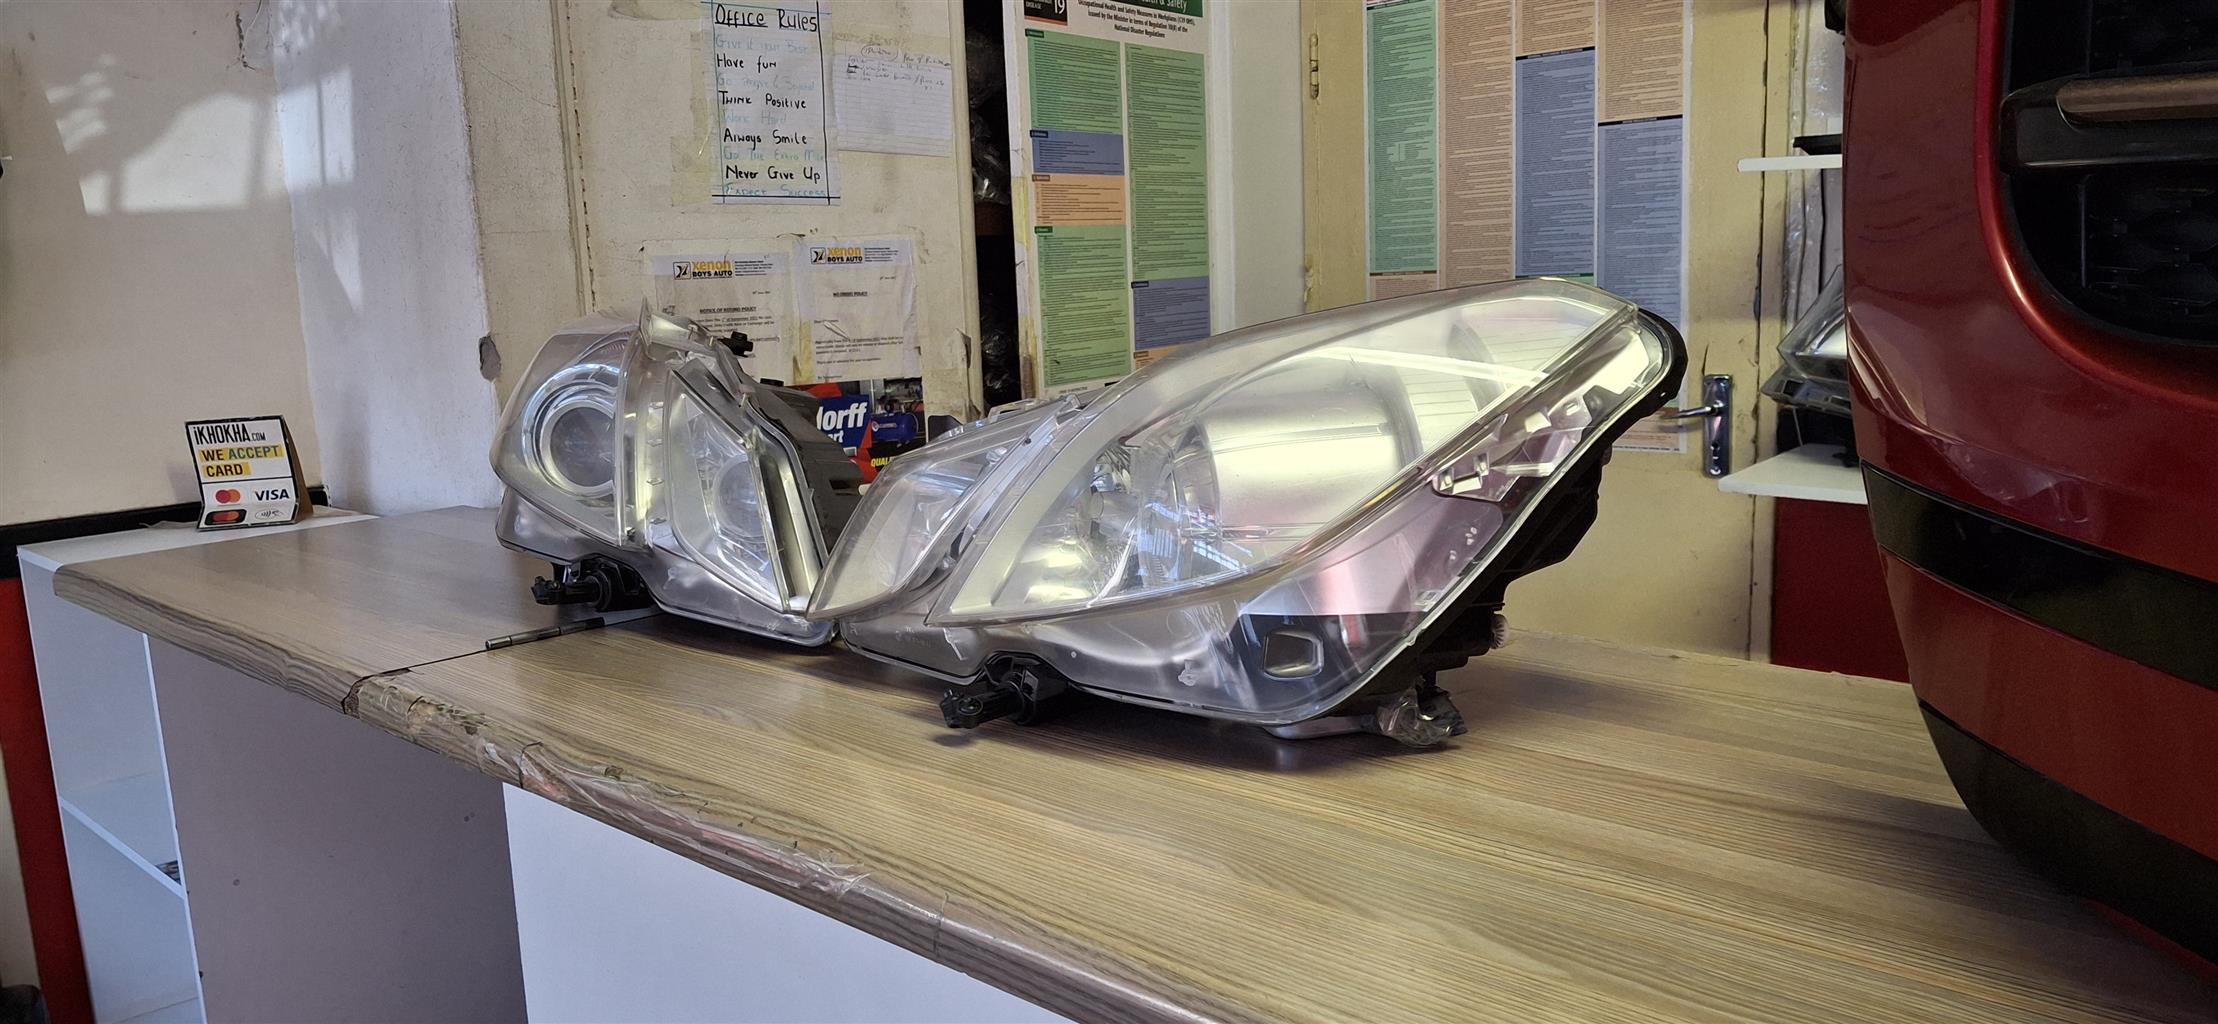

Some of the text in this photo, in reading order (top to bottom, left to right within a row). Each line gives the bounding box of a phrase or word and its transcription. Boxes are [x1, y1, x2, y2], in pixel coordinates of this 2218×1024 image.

[715, 3, 817, 32] Office Rules
[716, 53, 777, 73] Have fun
[765, 93, 806, 109] Positive
[723, 128, 807, 151] Always Smile
[726, 165, 821, 184] Never Give Up
[827, 247, 861, 256] xenon
[691, 260, 731, 271] xenon
[201, 445, 279, 461] WE ACCEPT
[206, 463, 243, 477] CARD
[254, 489, 290, 501] VISA
